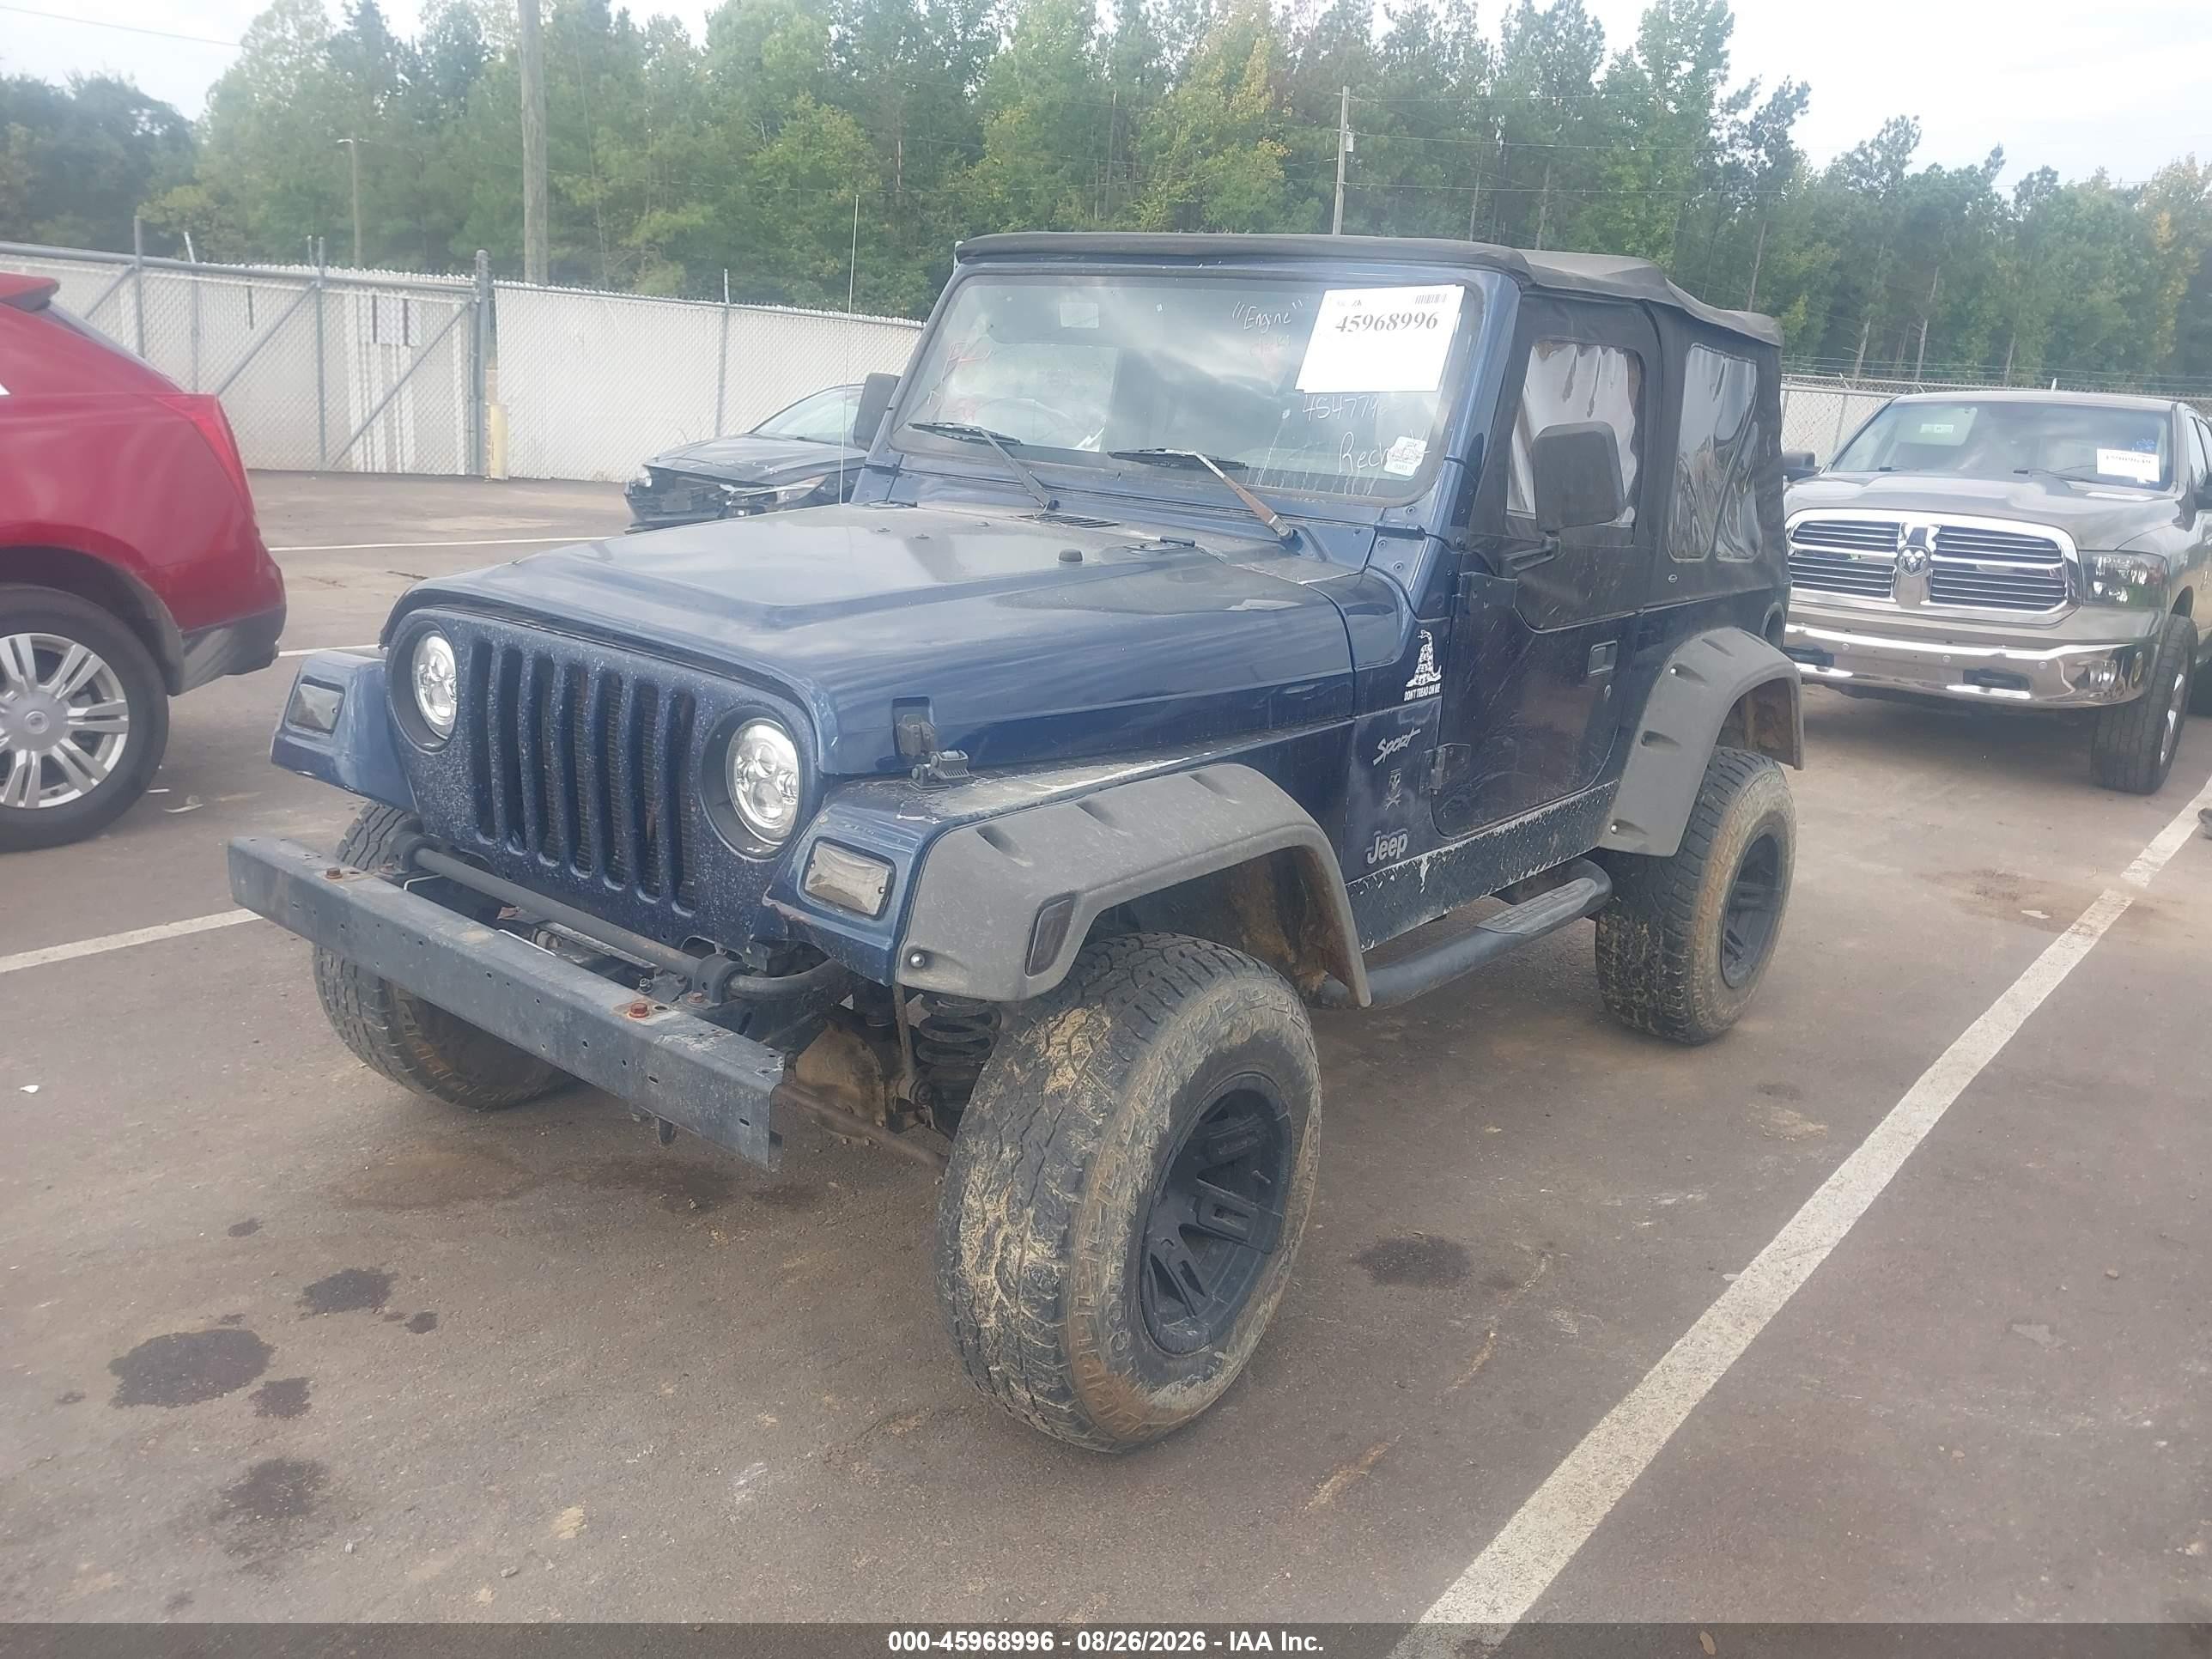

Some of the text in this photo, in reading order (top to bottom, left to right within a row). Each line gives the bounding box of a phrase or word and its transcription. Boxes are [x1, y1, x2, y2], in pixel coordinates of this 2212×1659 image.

[1334, 311, 1439, 332] 45968996
[1417, 686, 1429, 698] TREAD
[1365, 830, 1409, 865] Jeep
